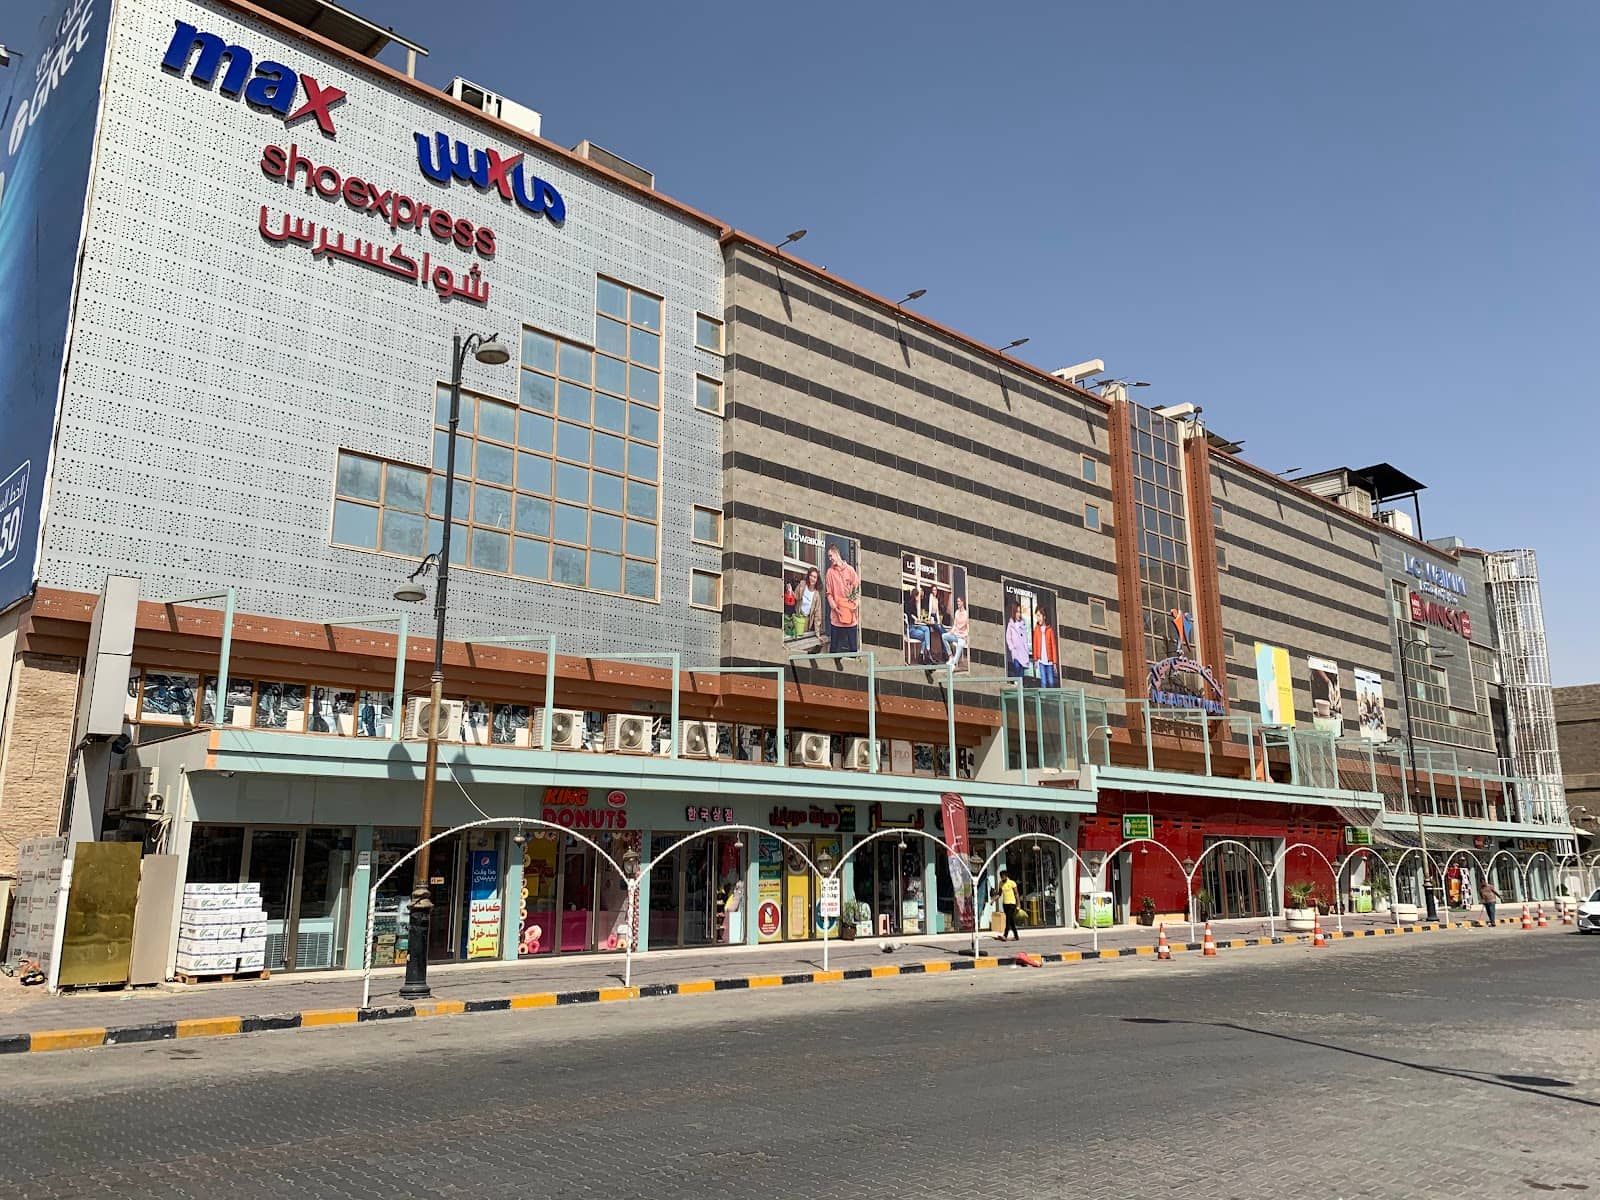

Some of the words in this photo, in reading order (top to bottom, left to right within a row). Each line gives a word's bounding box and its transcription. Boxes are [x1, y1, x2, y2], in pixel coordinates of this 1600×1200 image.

[28, 0, 94, 126] GREE
[161, 19, 347, 138] max
[260, 143, 497, 256] shoexpress
[543, 788, 588, 806] KING
[543, 808, 627, 829] DONUTS
[687, 806, 733, 822] 한국상점
